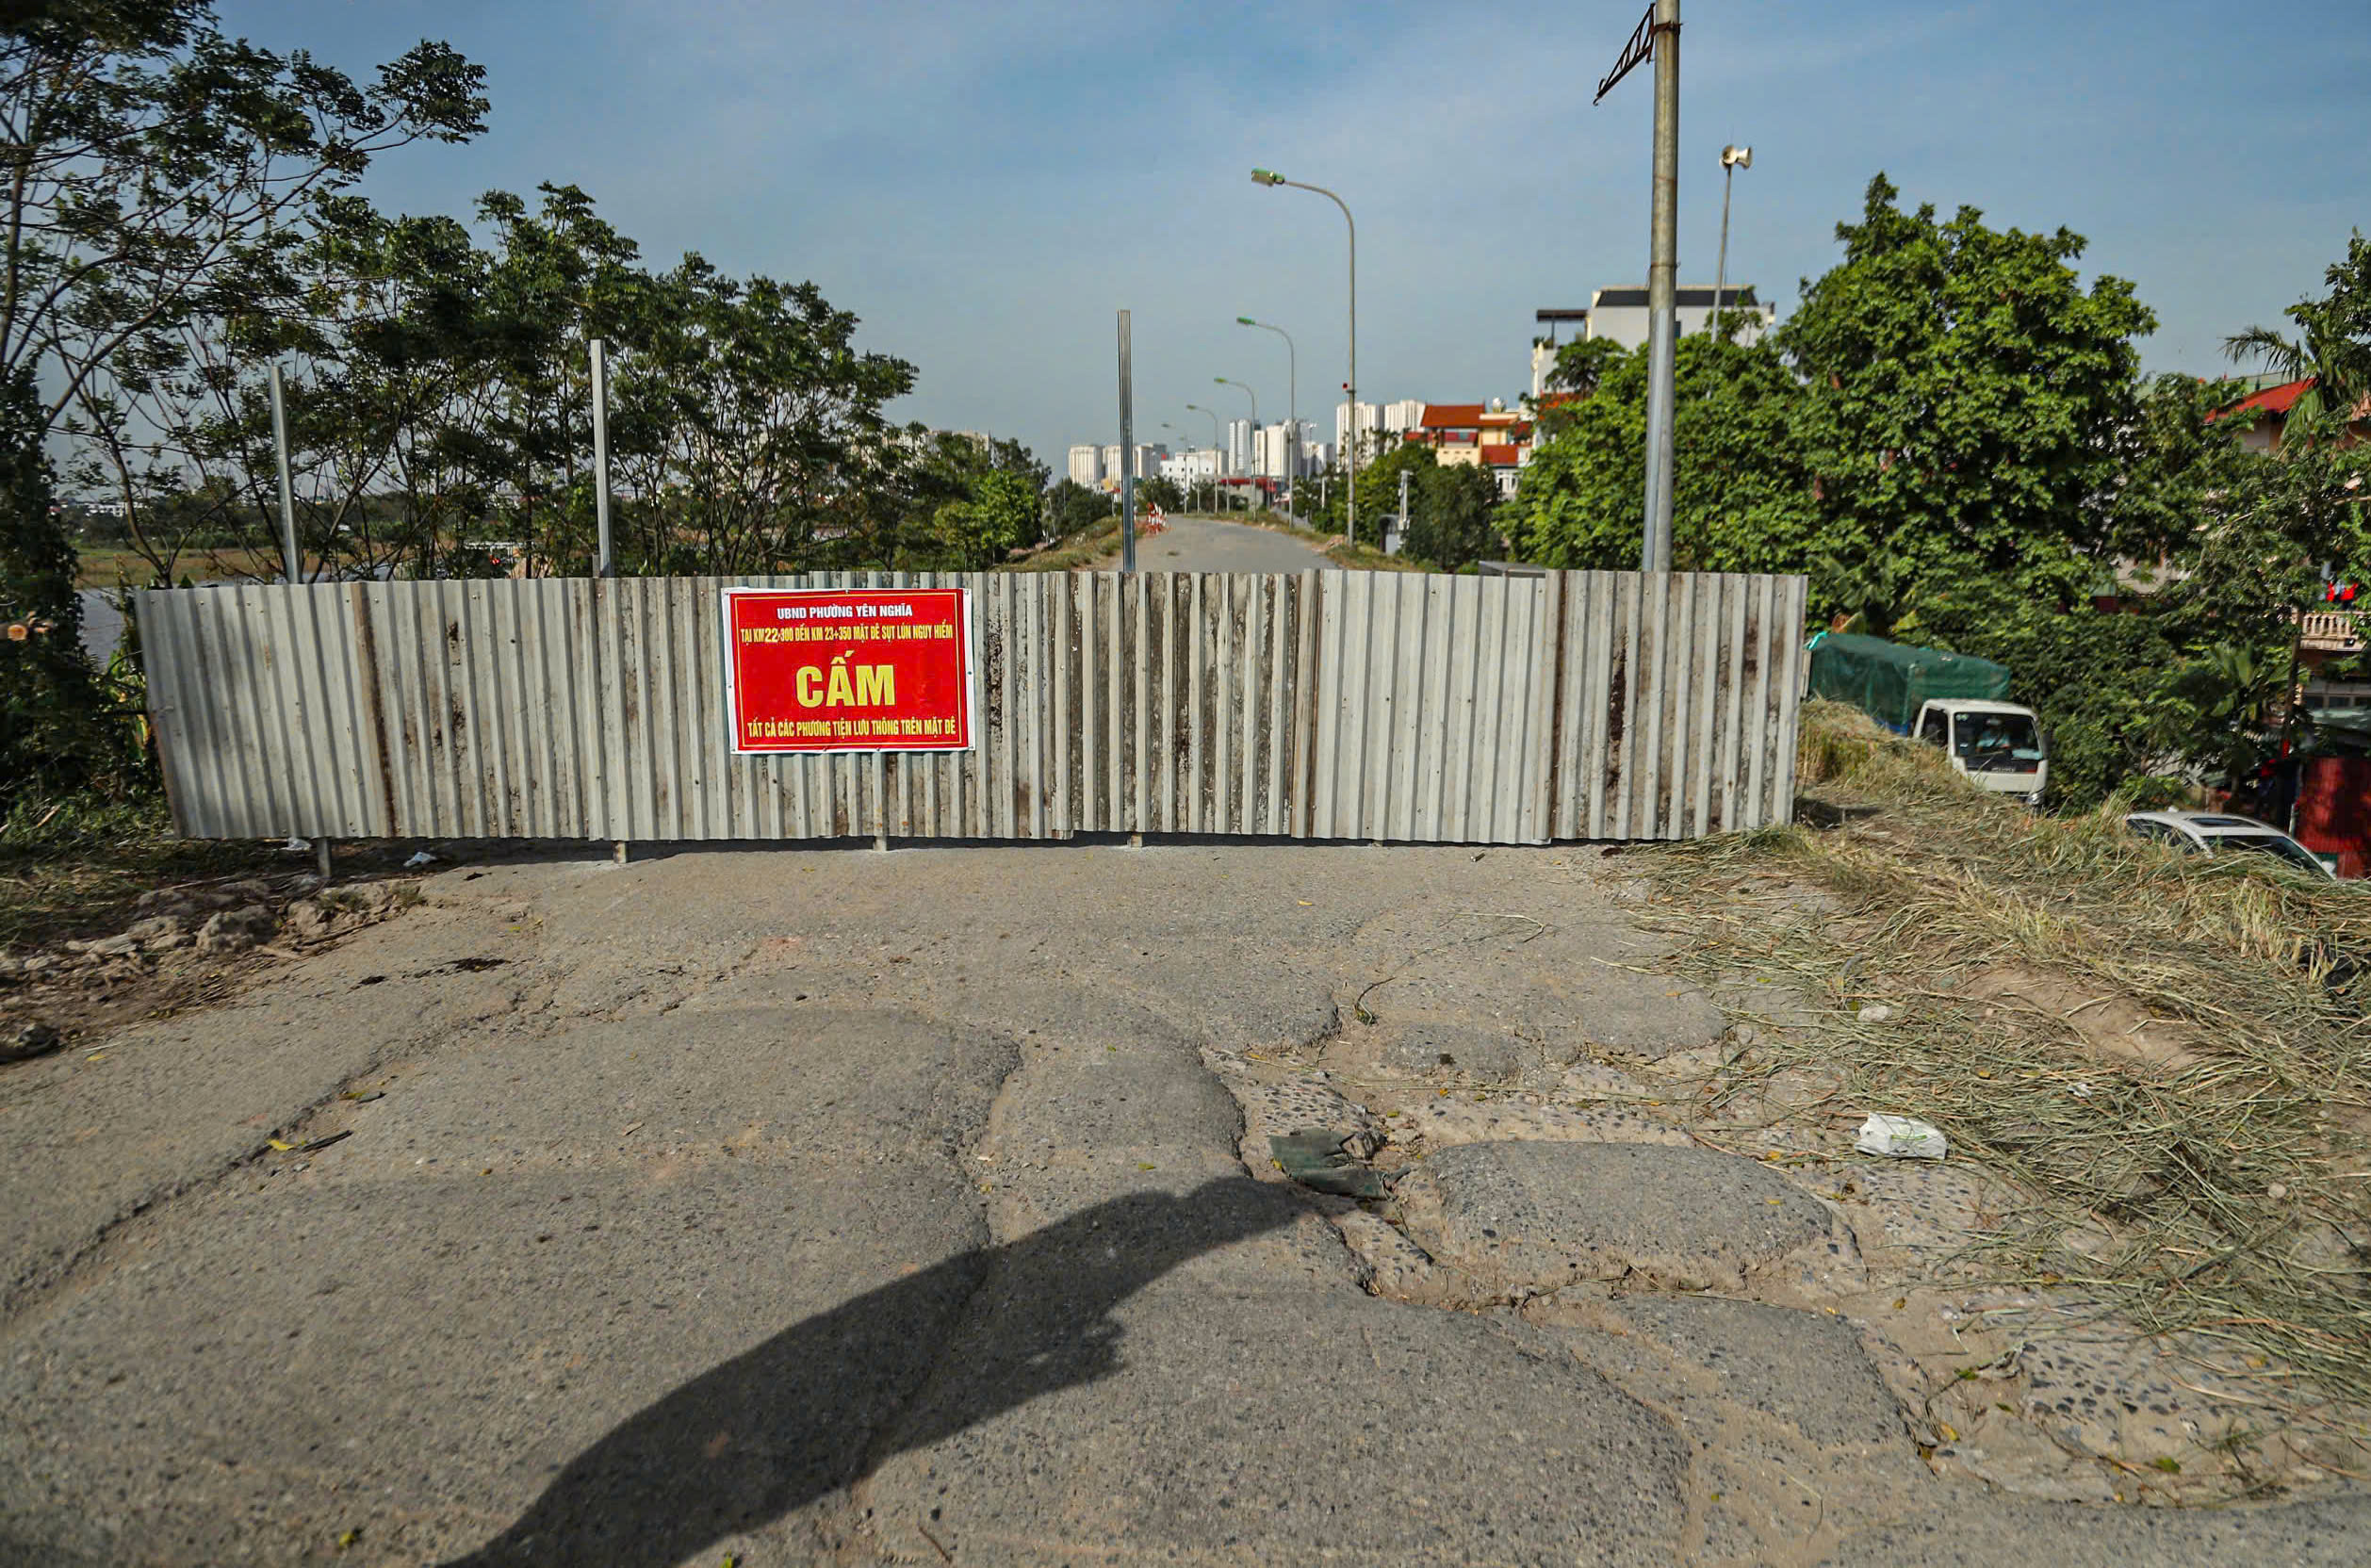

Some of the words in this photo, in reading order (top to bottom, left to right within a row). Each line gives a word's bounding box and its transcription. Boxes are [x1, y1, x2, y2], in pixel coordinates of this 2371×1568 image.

[777, 607, 807, 619] UBND
[809, 603, 853, 618] PHƯỜNG
[856, 602, 876, 617] YÊN
[879, 602, 913, 617] NGHĨA
[740, 628, 753, 646] TẠI
[810, 626, 824, 641] KM
[824, 625, 852, 641] 23+350
[853, 623, 869, 644] MẶT
[881, 625, 895, 643] SỤT
[896, 622, 911, 640] LÚN
[912, 624, 933, 640] NGUY
[795, 649, 895, 709] CẤM
[746, 716, 762, 738] TẤT
[764, 716, 777, 738] CẢ
[777, 718, 794, 737] CÁC
[795, 719, 831, 737] PHƯƠNG
[832, 716, 852, 740] TIỆN
[871, 716, 899, 736] THÔNG
[900, 716, 923, 735] TRÊN
[924, 716, 942, 739] MẶT
